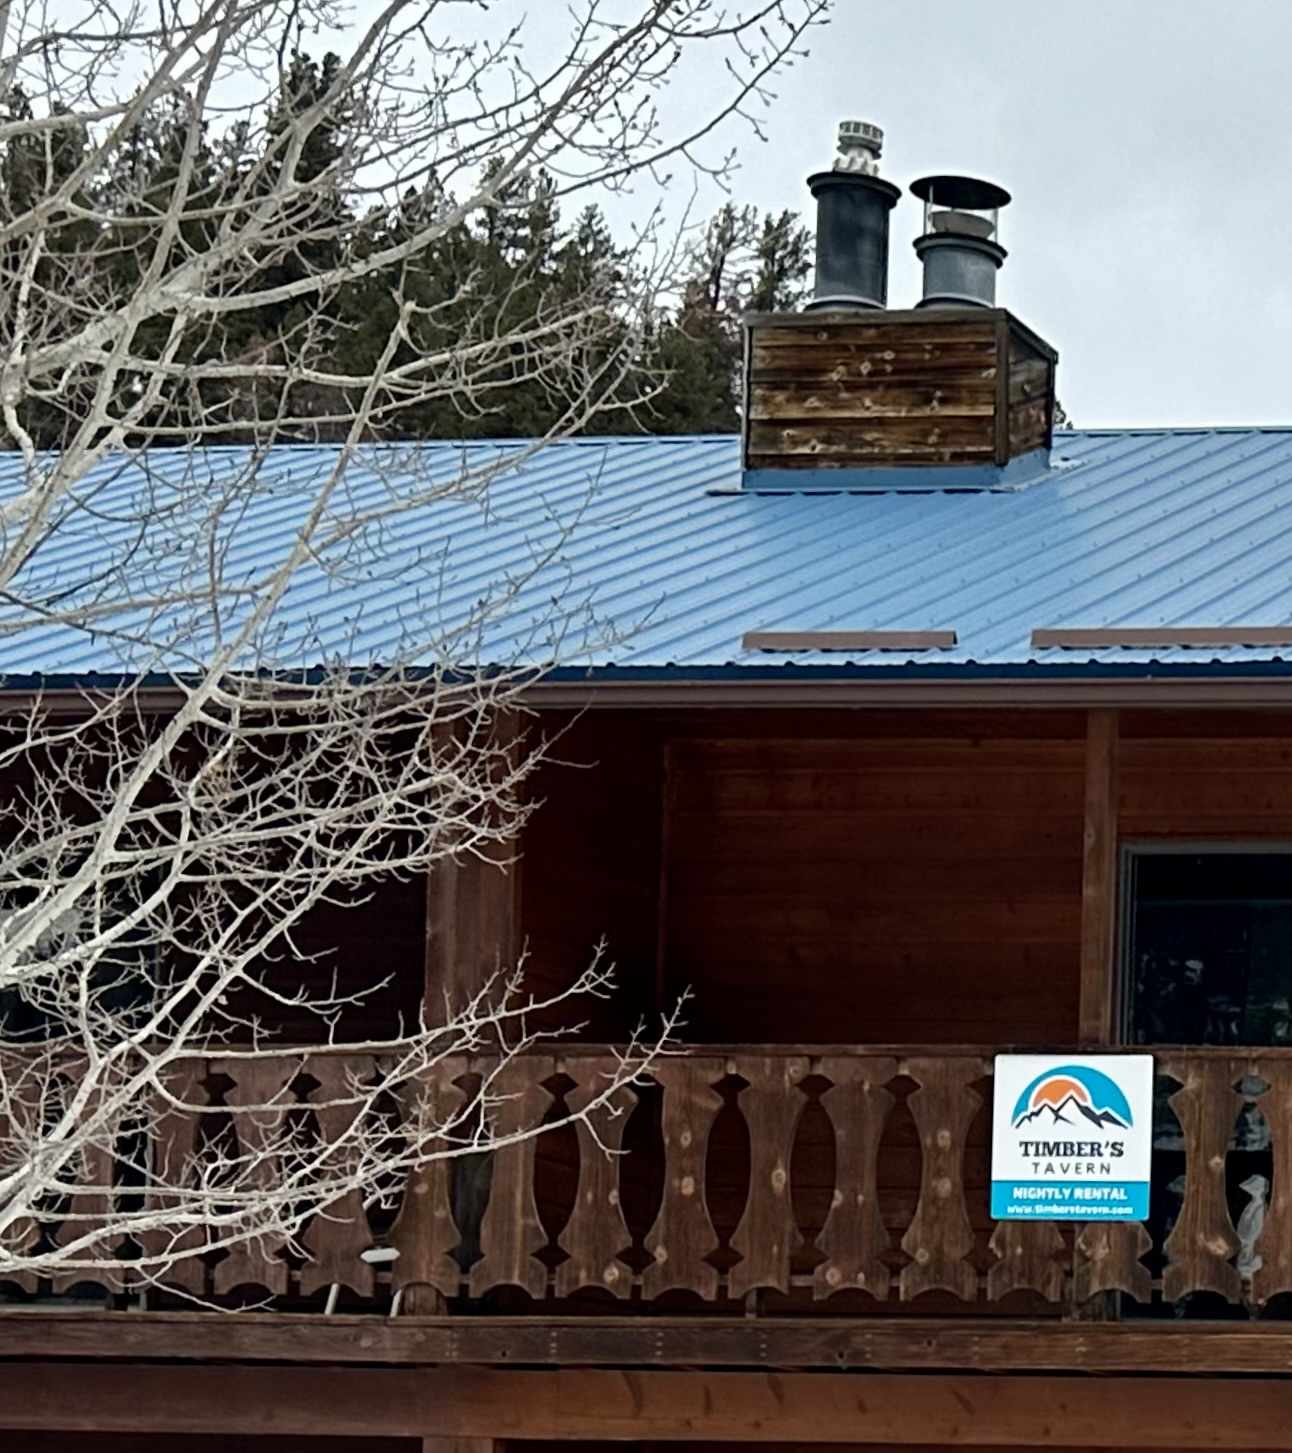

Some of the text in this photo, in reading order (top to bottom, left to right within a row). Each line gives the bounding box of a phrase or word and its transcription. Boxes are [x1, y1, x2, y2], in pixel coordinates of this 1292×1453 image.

[1019, 1140, 1124, 1158] TIMBER'S
[1032, 1162, 1111, 1175] TAVERN
[1013, 1187, 1127, 1200] NIGHTLY RENTAL
